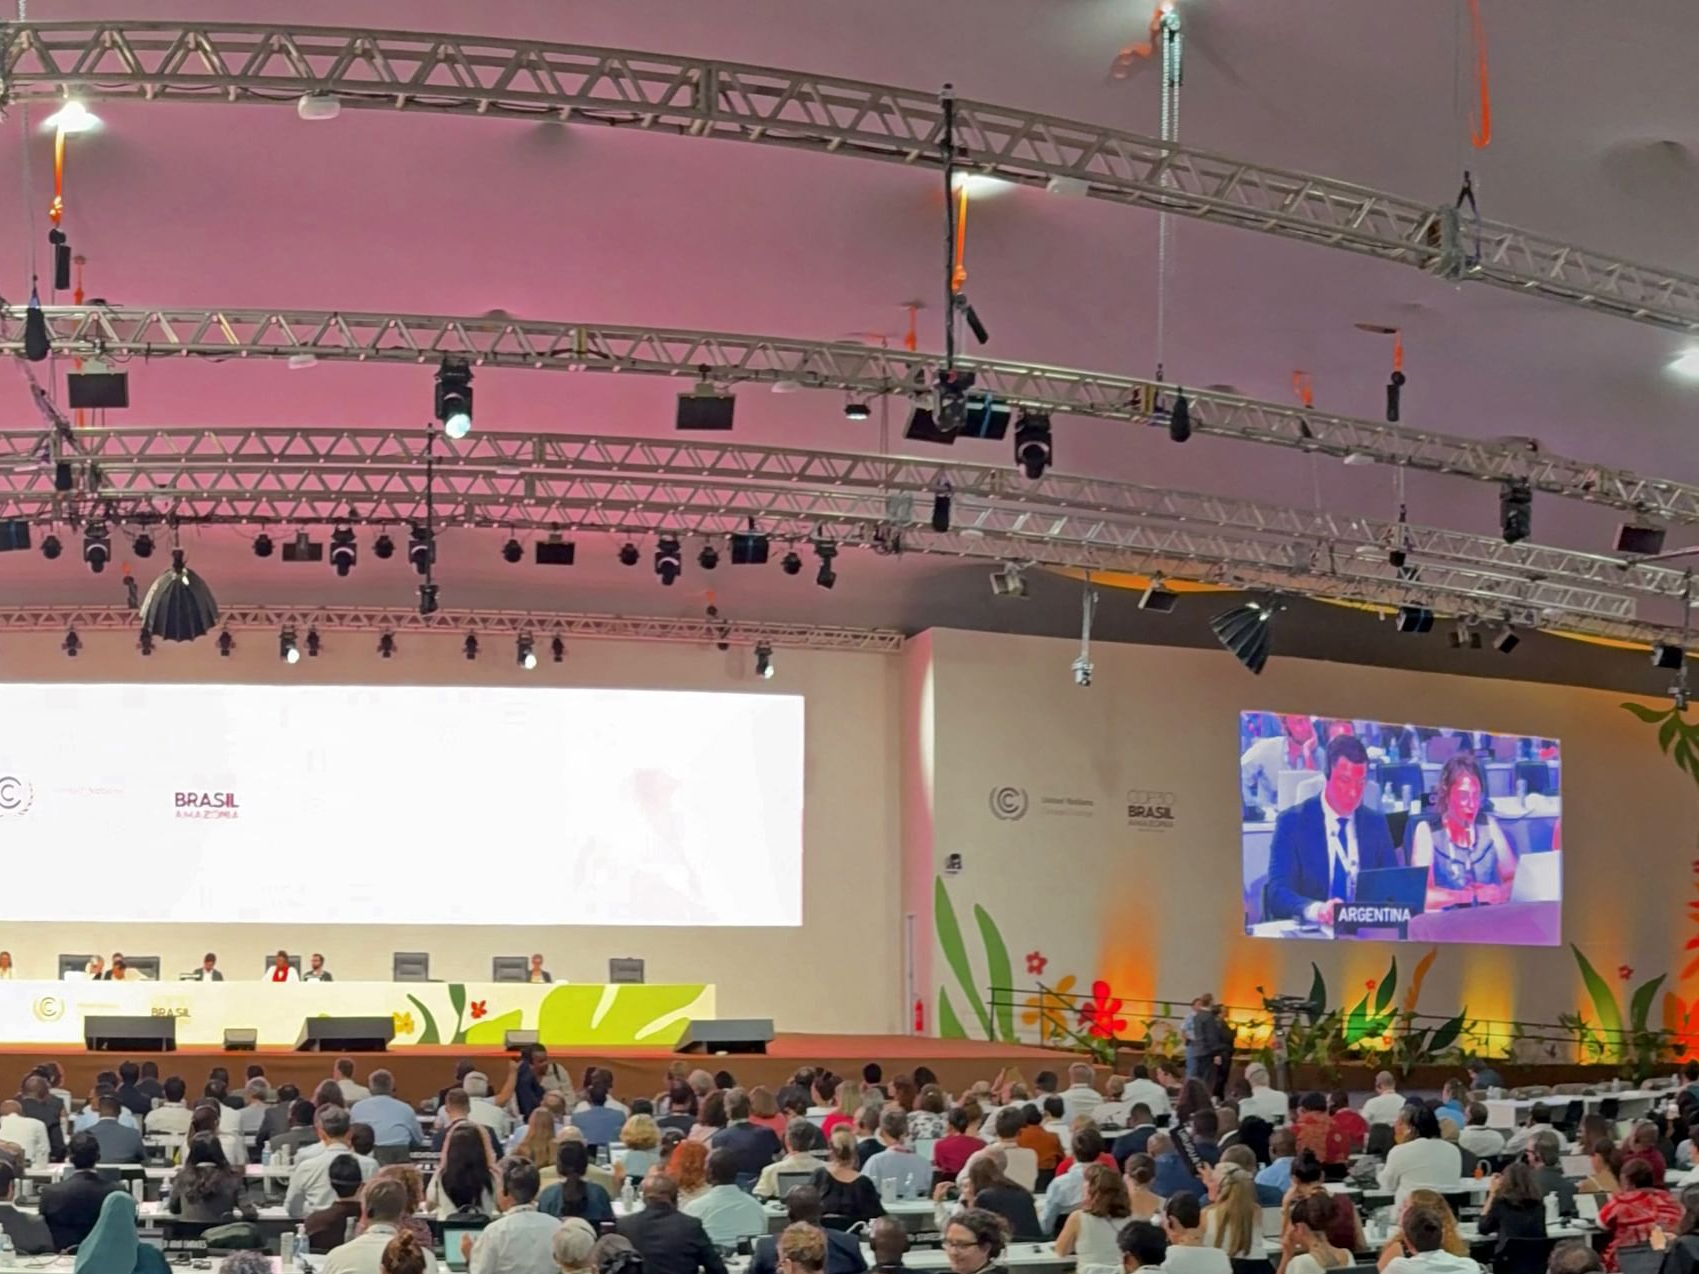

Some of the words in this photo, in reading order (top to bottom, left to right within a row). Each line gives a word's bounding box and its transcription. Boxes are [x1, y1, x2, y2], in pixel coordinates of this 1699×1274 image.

[174, 792, 239, 808] BRASIL
[1127, 805, 1175, 819] BRASIL
[1338, 907, 1412, 922] ARGENTINA
[151, 1008, 192, 1018] BRASIL
